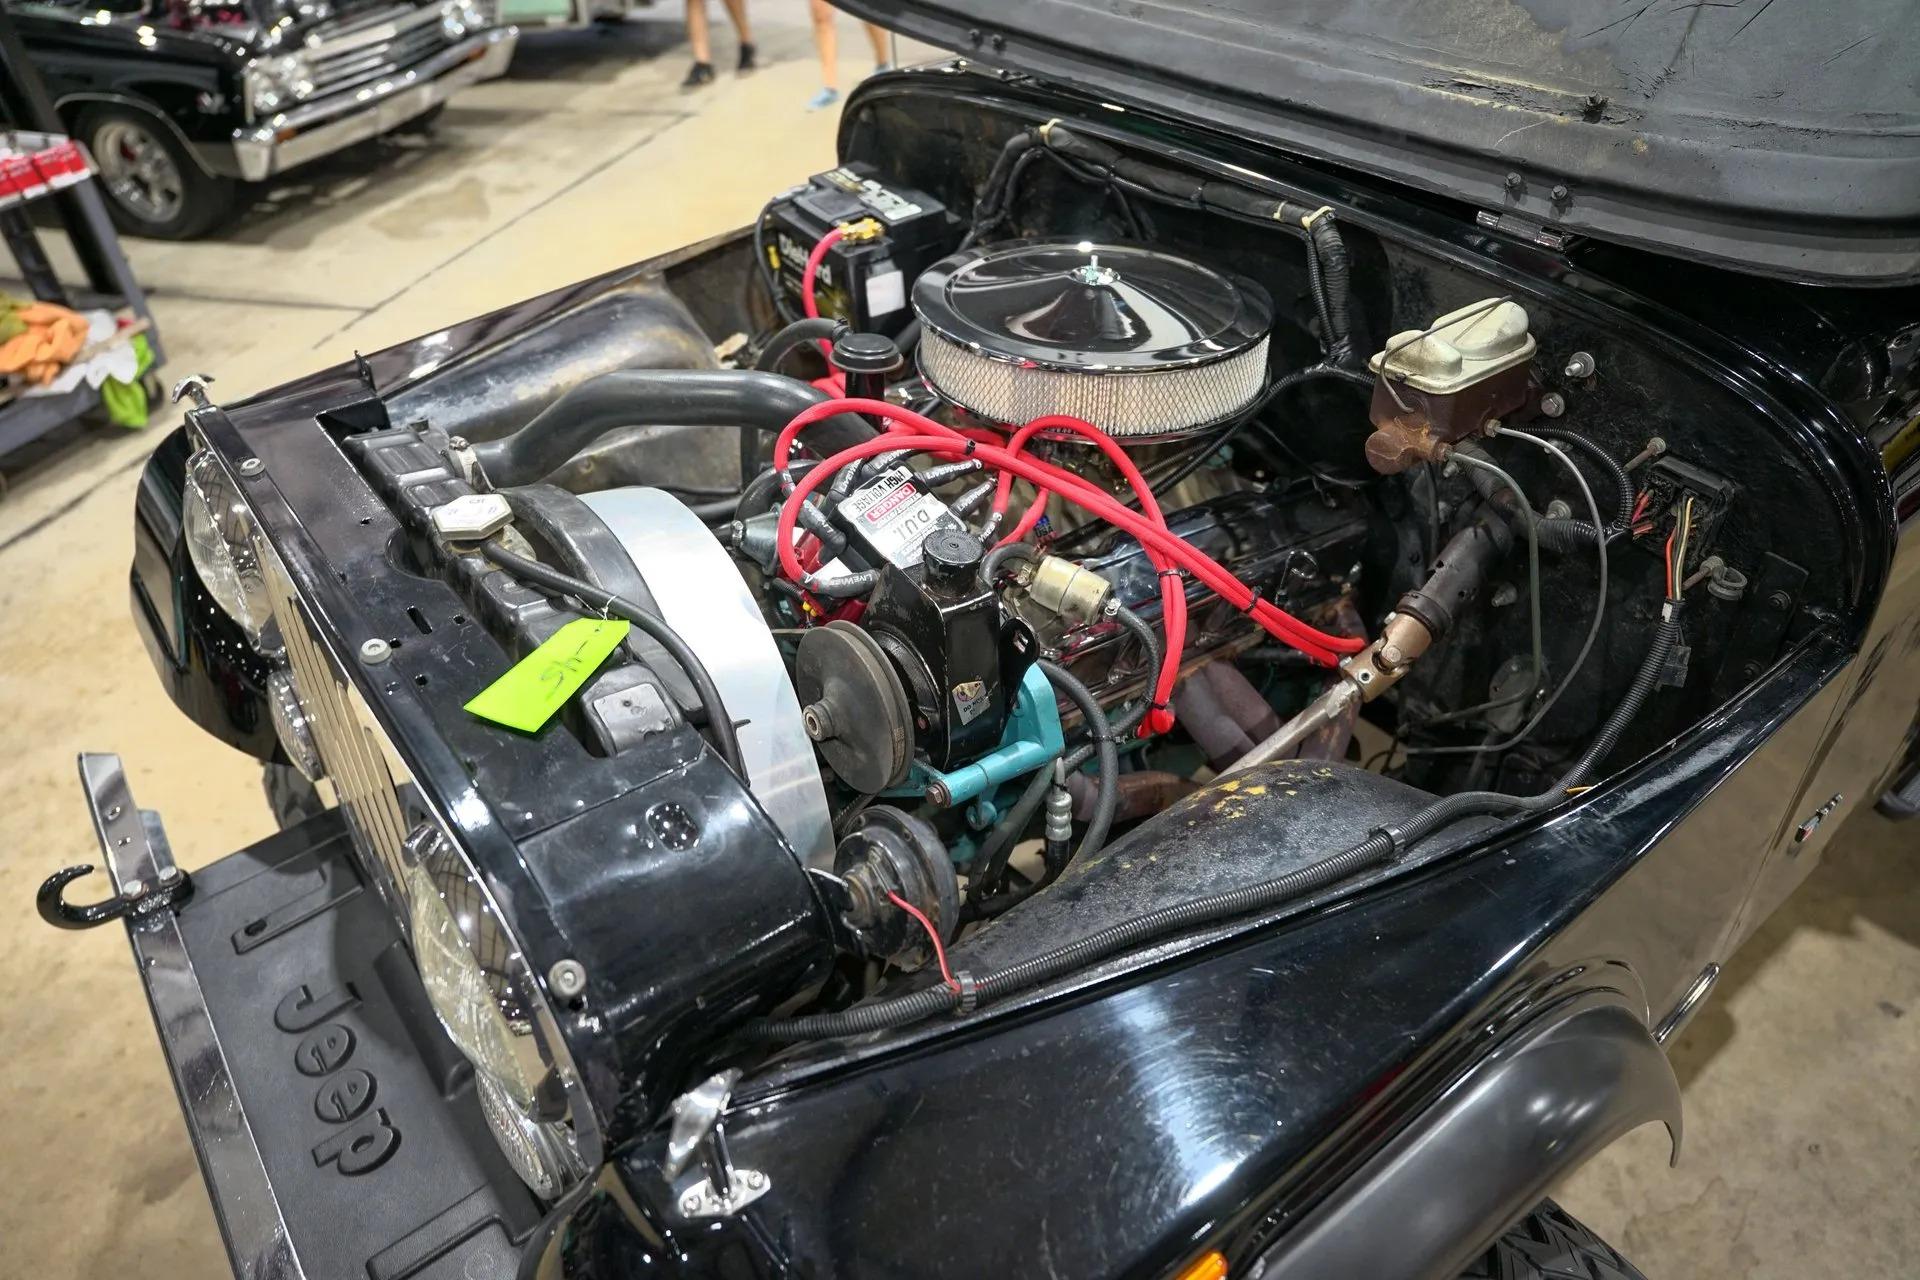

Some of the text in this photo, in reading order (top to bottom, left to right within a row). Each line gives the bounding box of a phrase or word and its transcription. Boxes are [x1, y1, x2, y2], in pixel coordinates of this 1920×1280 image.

[852, 470, 906, 513] HIGH VOLTAGE
[868, 485, 913, 520] DANGER
[274, 981, 402, 1177] Jeep
